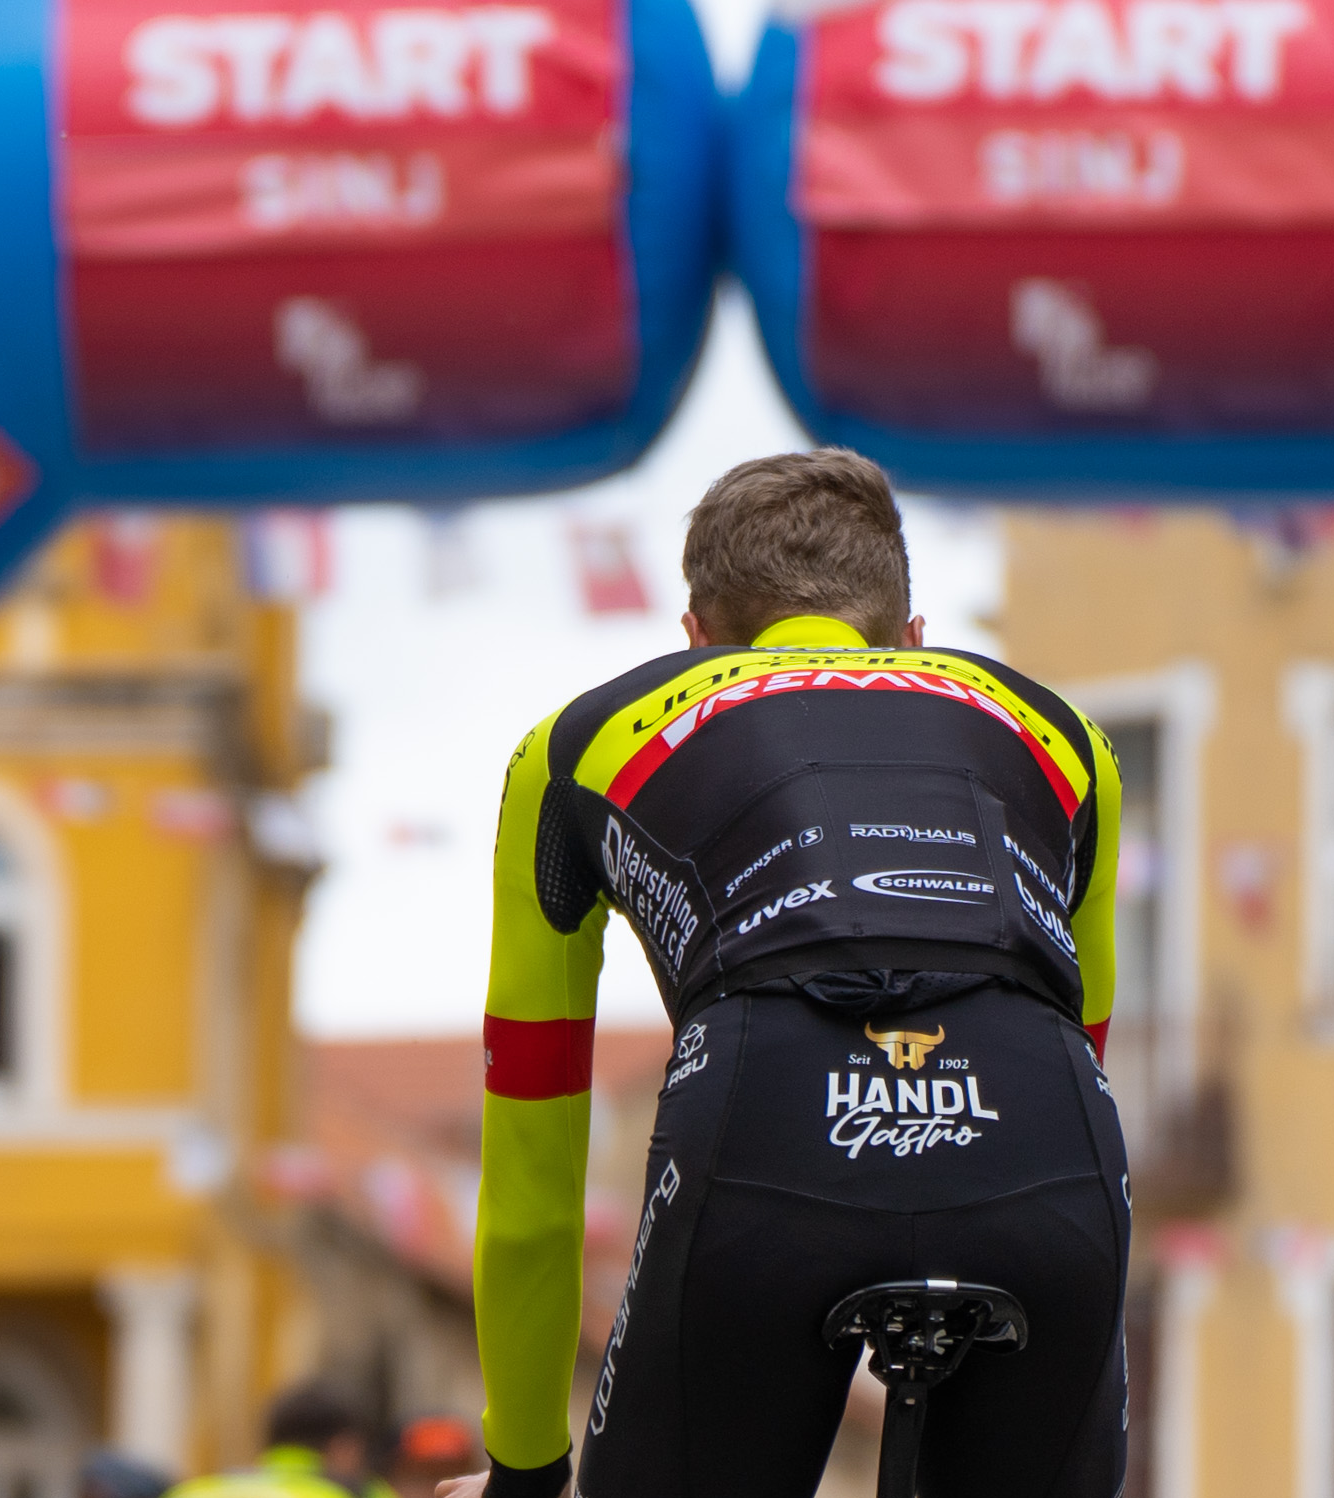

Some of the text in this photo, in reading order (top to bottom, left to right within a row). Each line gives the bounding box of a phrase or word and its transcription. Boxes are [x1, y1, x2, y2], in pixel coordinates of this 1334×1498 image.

[127, 10, 551, 125] START
[877, 0, 1313, 100] START
[701, 670, 1024, 734] REMUS
[621, 834, 699, 946] Hairstyling
[725, 838, 793, 898] SPONSER
[878, 876, 995, 894] SCHWALBE
[1002, 834, 1069, 906] NATIVE
[620, 867, 686, 971] Dietrich
[737, 879, 838, 935] uvex
[667, 1053, 709, 1089] AGU
[847, 1053, 970, 1070] Seit 1902
[826, 1071, 1000, 1121] HANDL
[829, 1099, 983, 1160] Gastro
